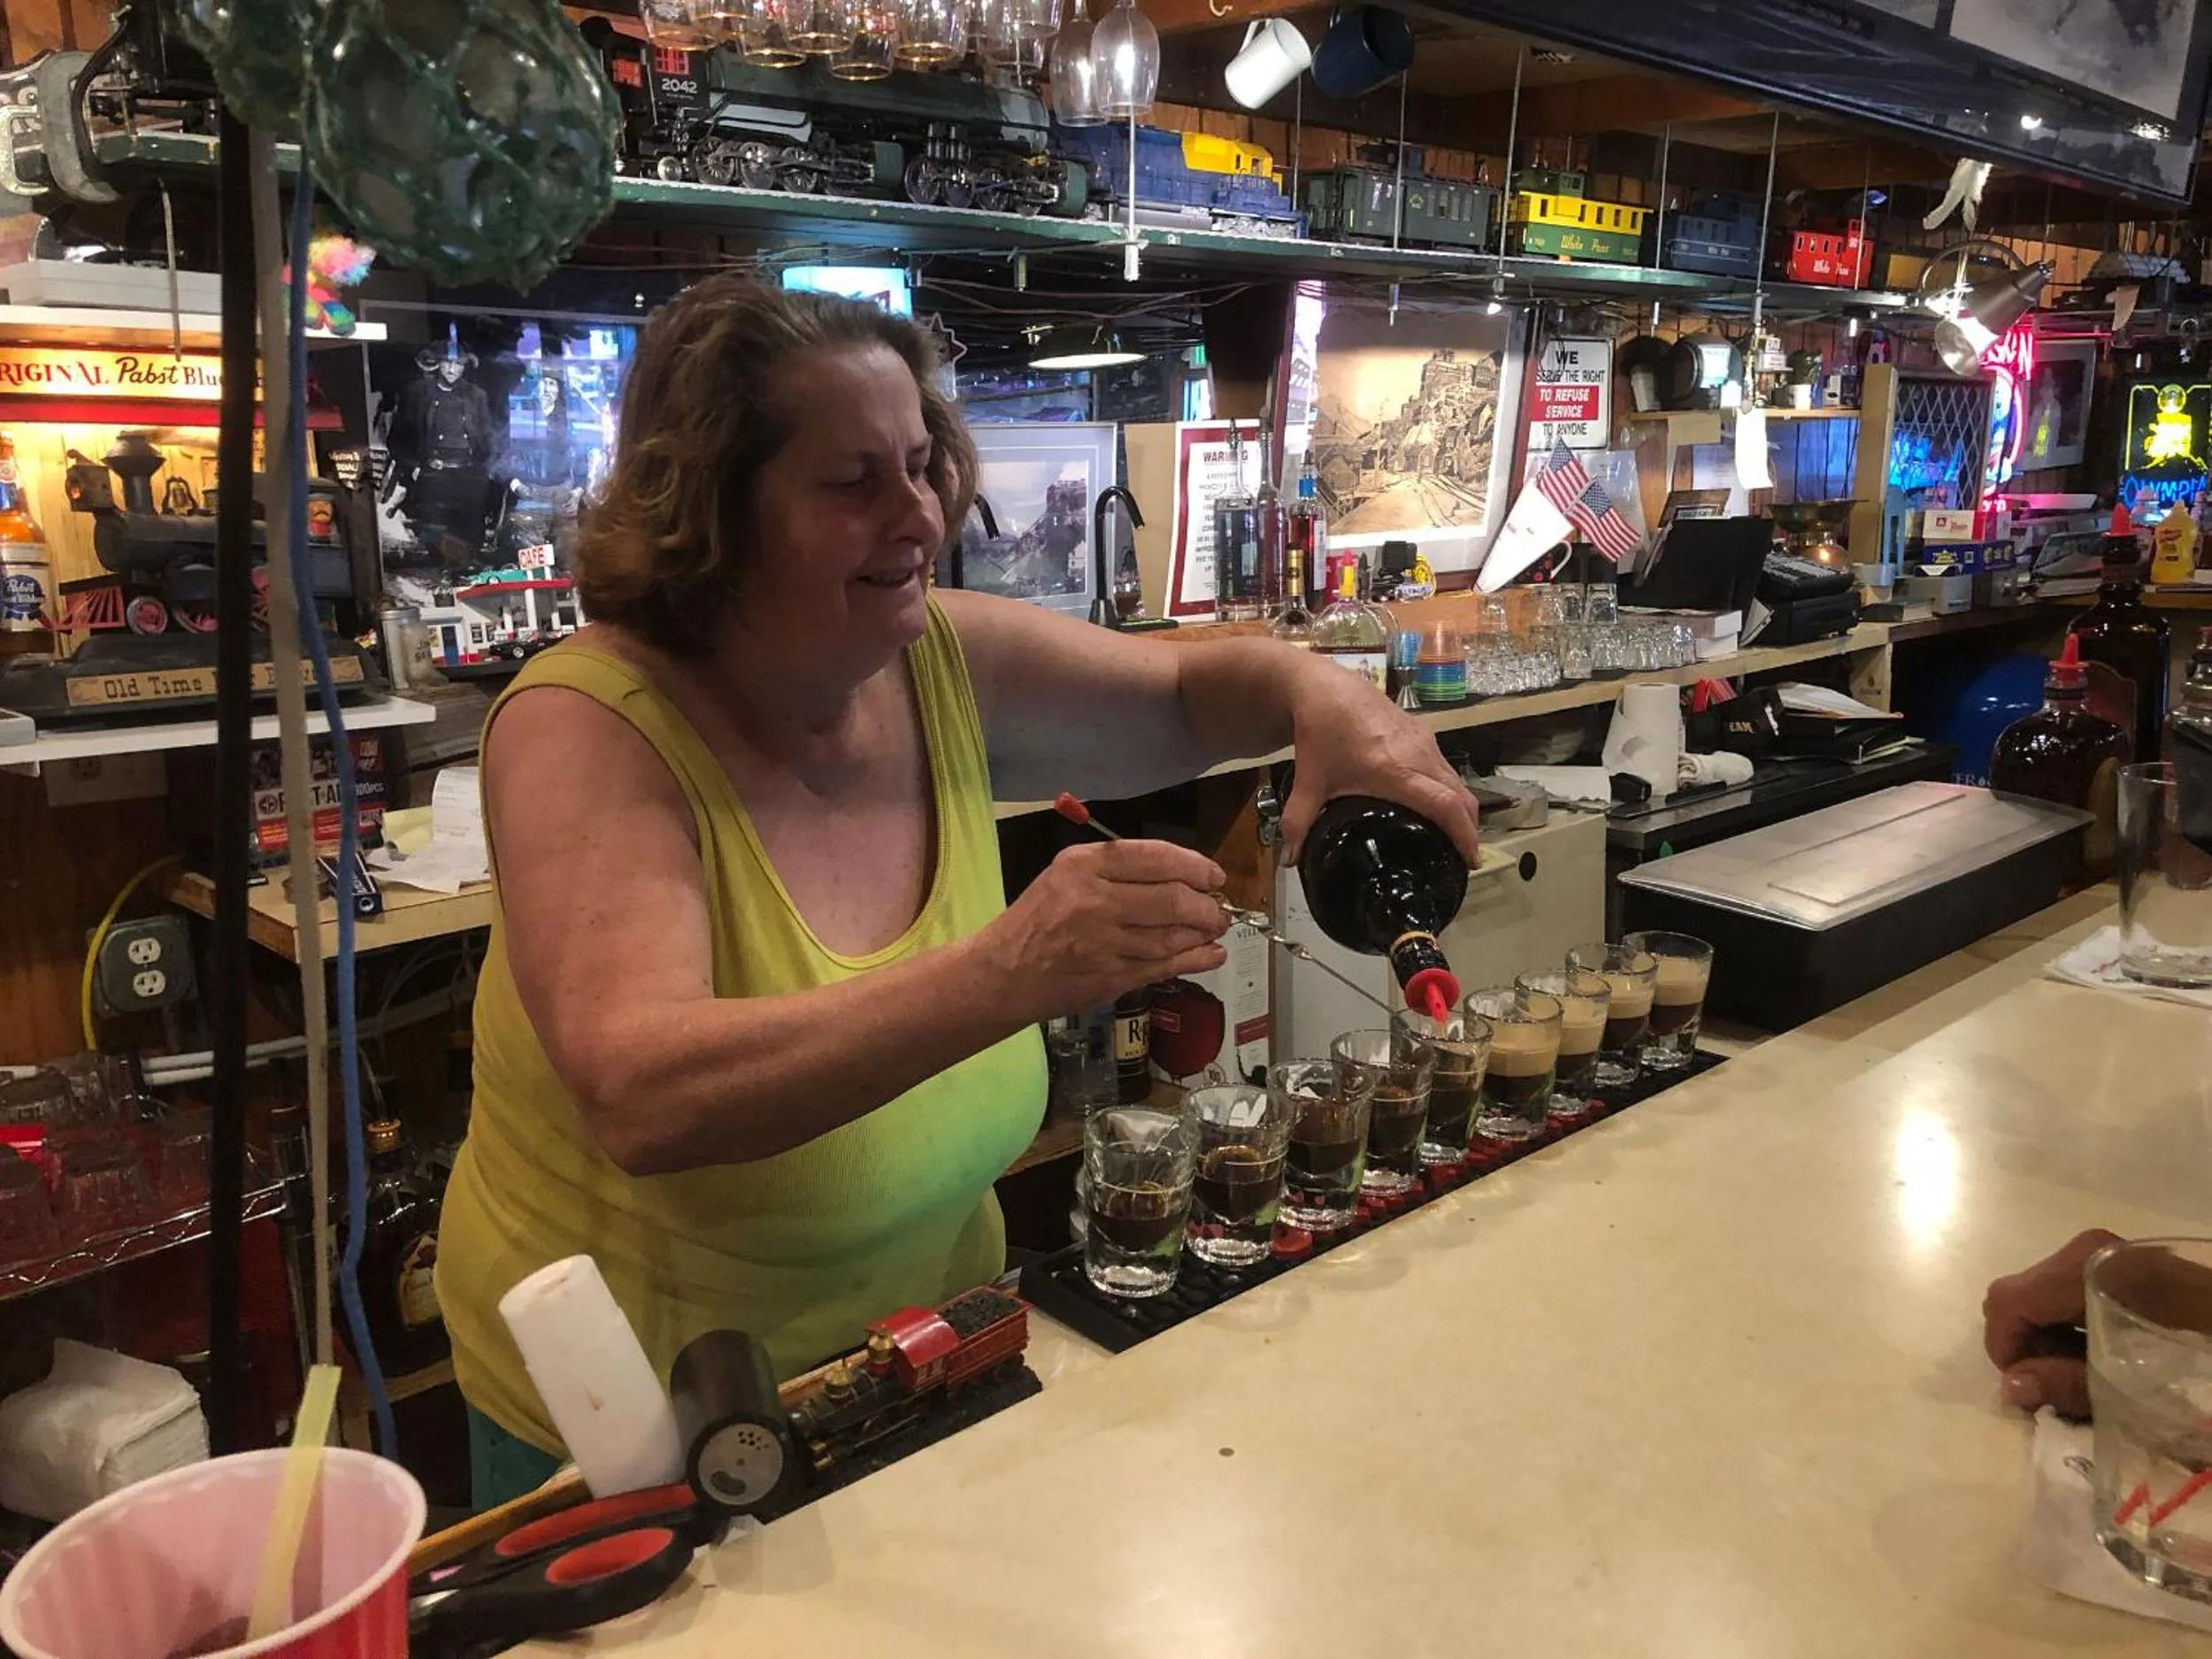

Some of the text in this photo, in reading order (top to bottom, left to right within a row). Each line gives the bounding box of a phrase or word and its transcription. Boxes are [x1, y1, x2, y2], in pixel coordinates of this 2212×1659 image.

[661, 77, 698, 94] 2042
[1555, 350, 1579, 365] WE
[0, 357, 223, 387] RIGINAL Pabst Blu
[1563, 370, 1580, 382] THE
[1581, 370, 1605, 382] RIGHT
[1540, 388, 1590, 402] TO REFUSE
[1545, 405, 1583, 419] SERVICE
[1543, 423, 1587, 436] TO ANYONE
[1202, 449, 1248, 463] WARG
[520, 546, 545, 569] CAFE
[104, 680, 141, 699] Old
[148, 675, 203, 695] Time
